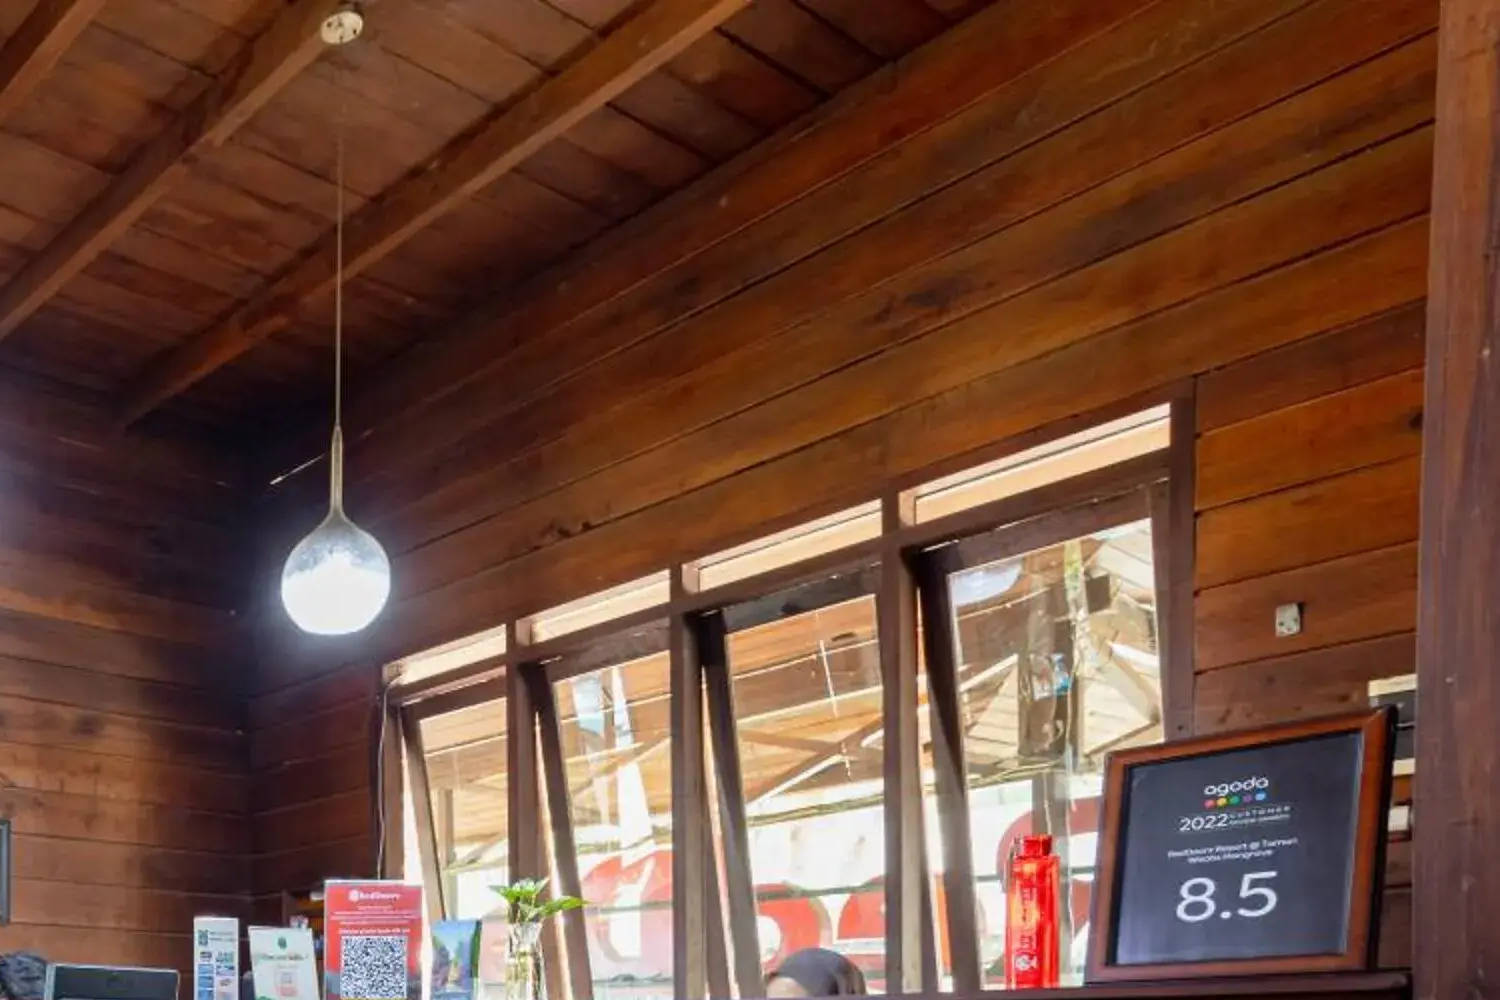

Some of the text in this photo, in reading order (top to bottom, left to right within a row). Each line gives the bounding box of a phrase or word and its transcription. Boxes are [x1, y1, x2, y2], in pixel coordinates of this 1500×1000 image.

[1203, 776, 1269, 797] agoda
[1179, 813, 1229, 832] 2022
[1176, 871, 1278, 923] 8.5
